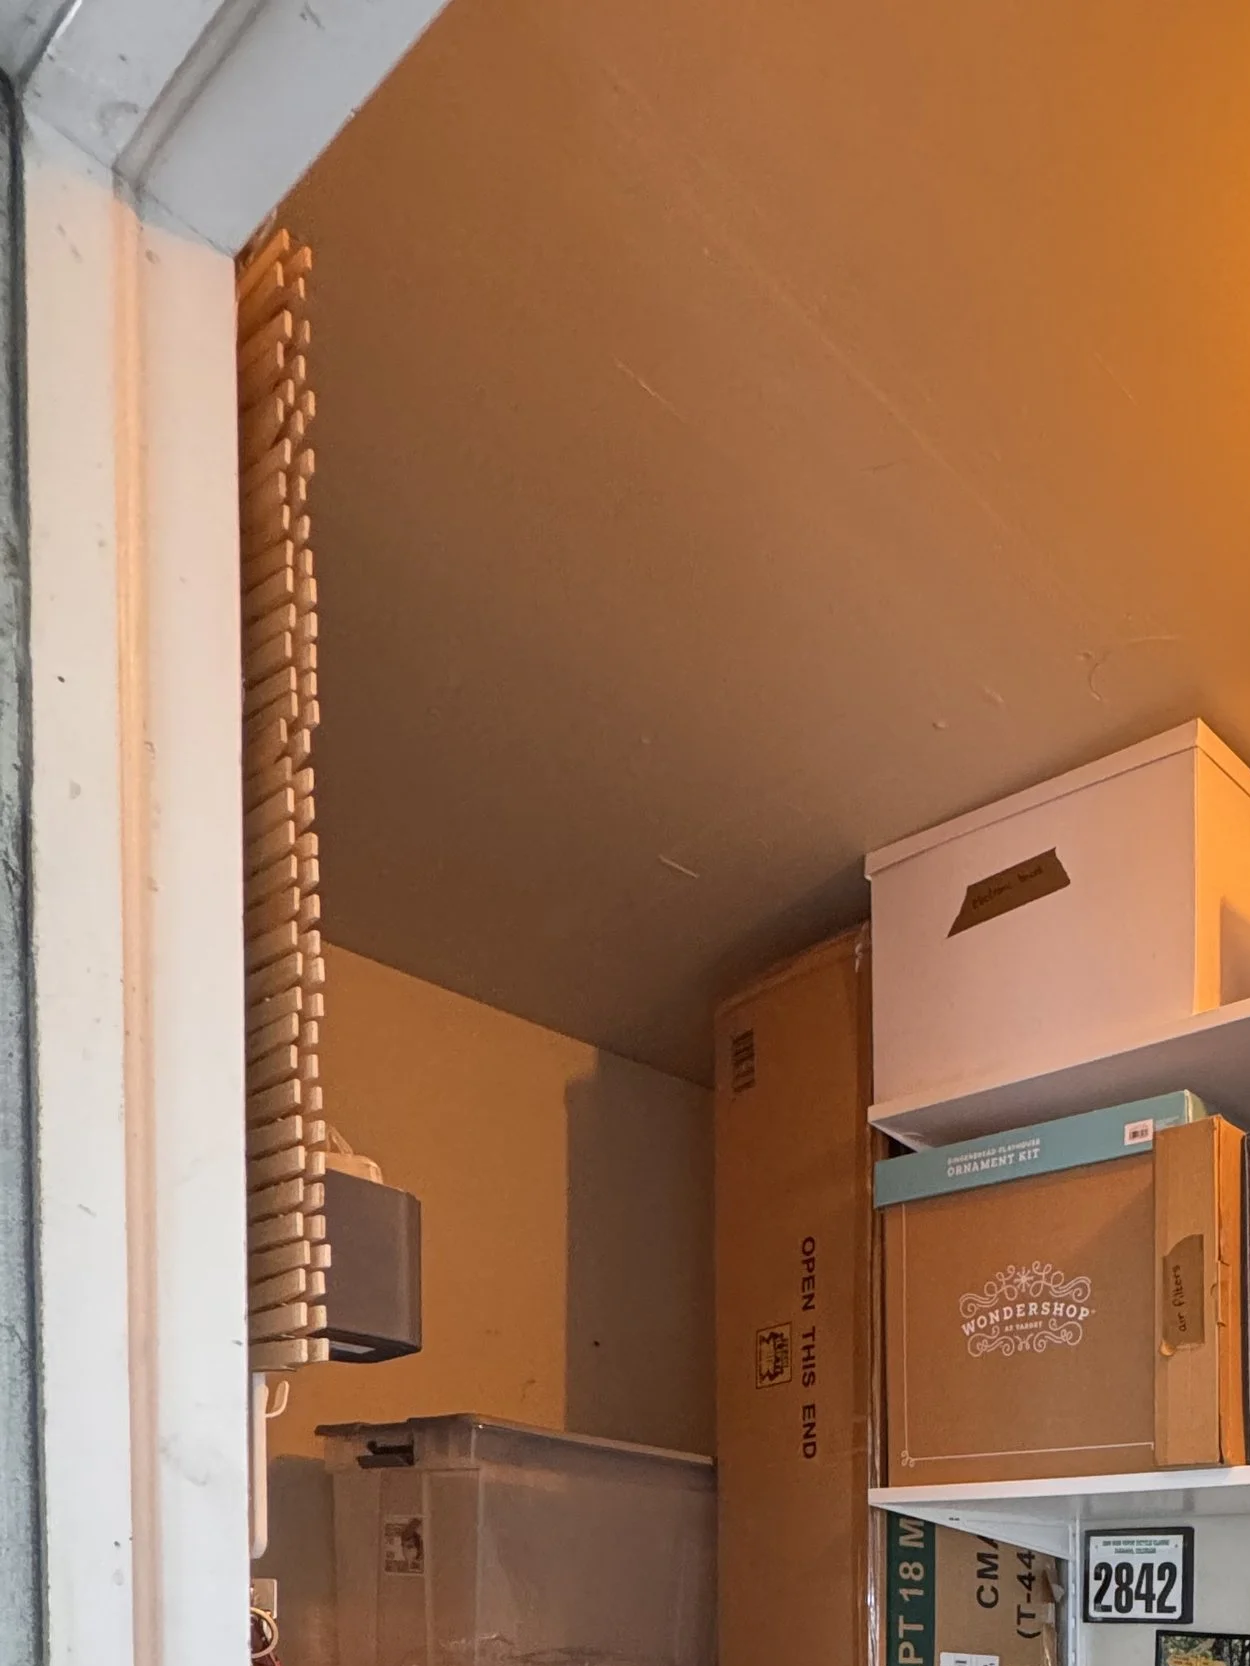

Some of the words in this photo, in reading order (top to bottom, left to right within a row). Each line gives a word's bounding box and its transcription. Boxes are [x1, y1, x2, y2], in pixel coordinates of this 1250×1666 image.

[947, 1153, 1015, 1177] ORNAMENT
[1018, 1148, 1041, 1163] KIT
[801, 1235, 816, 1312] OPEN
[961, 1301, 1091, 1337] WONDERSHOP
[802, 1325, 816, 1388] THIS
[802, 1404, 818, 1459] END
[900, 1562, 925, 1602] 18
[1094, 1561, 1177, 1614] 2842
